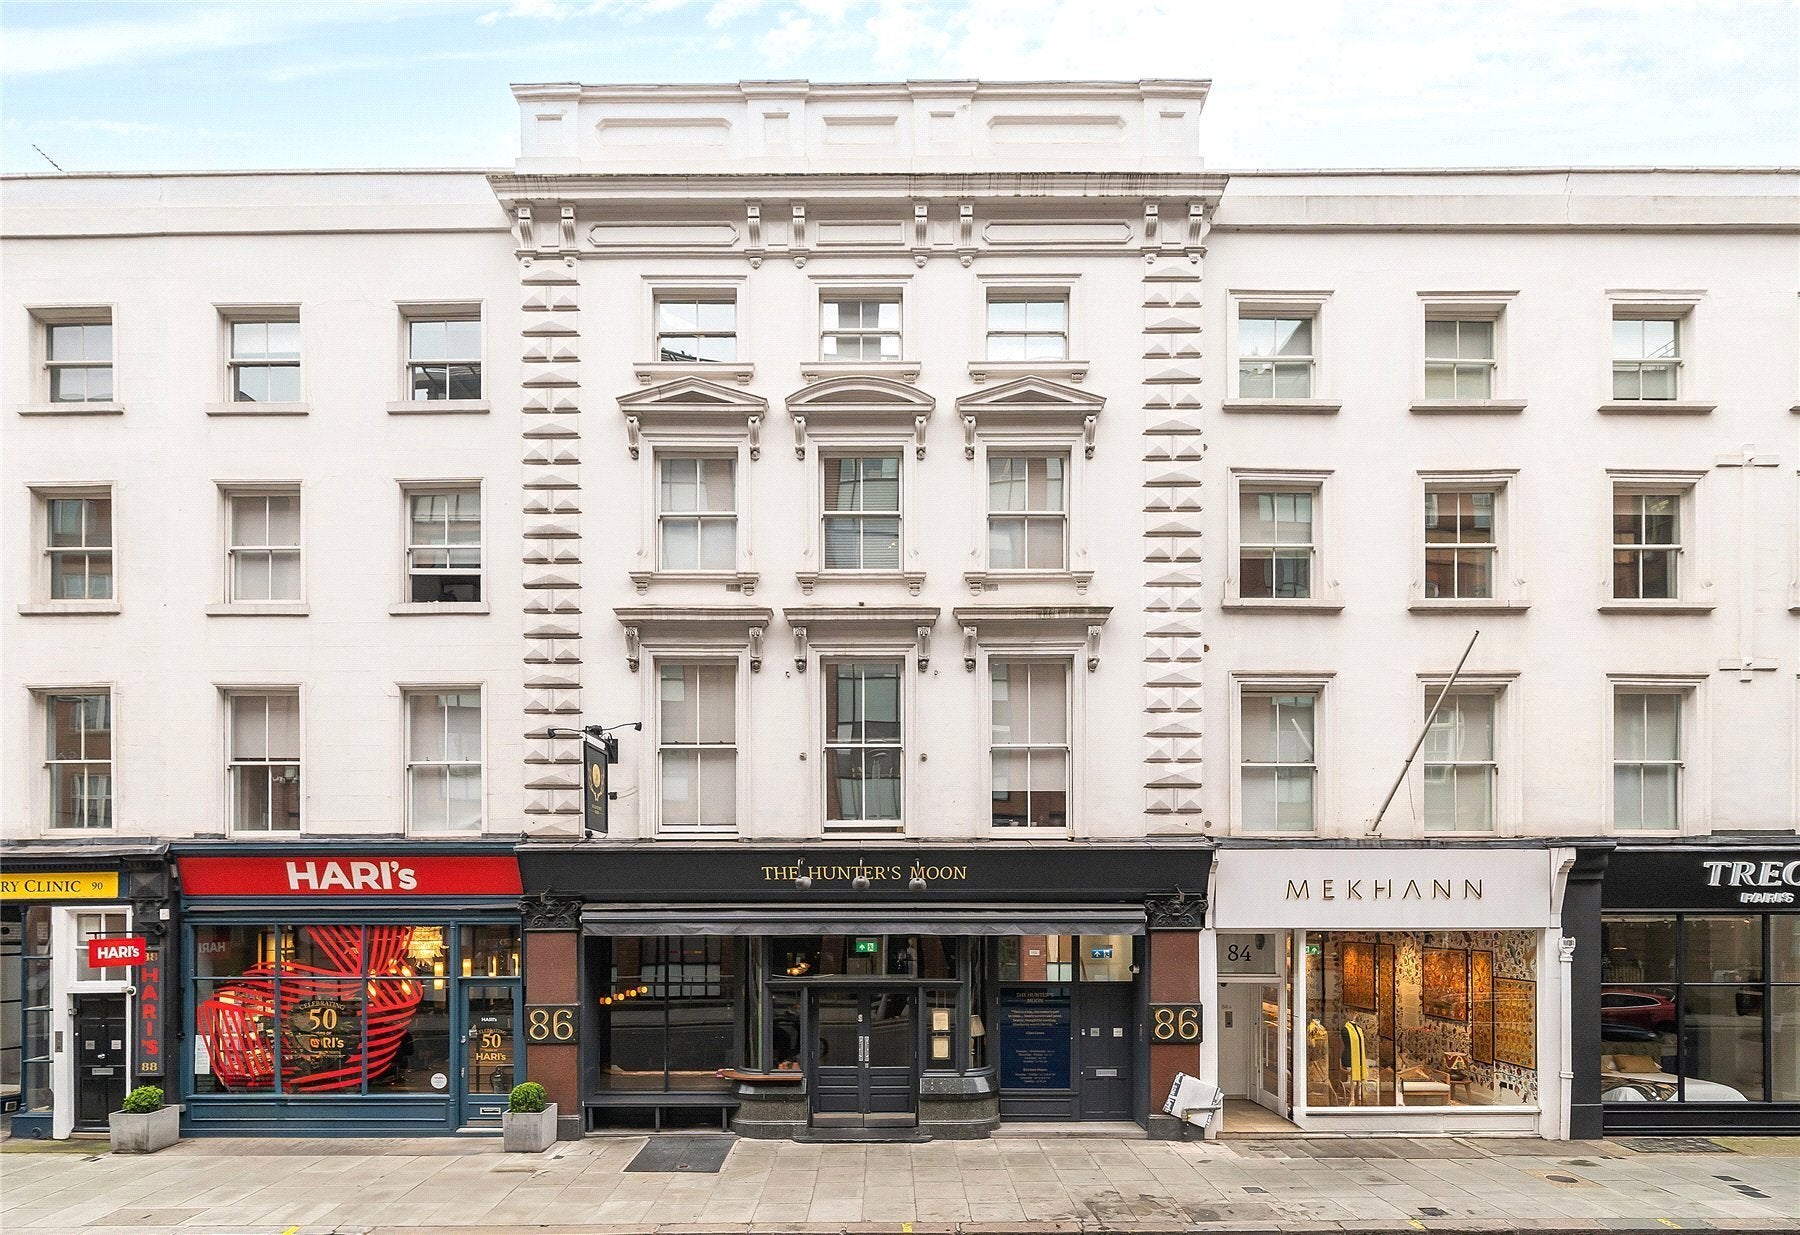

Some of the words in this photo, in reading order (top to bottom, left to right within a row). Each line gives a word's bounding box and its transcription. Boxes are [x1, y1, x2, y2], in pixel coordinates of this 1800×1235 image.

[761, 866, 798, 880] THE
[809, 866, 901, 880] HUNTER'S
[909, 866, 967, 880] MOON
[24, 880, 81, 893] CLINIC
[91, 882, 103, 890] 90
[1286, 879, 1482, 900] MEKHANN
[1740, 892, 1795, 903] PARIS
[1228, 944, 1251, 961] 84
[309, 1008, 337, 1030] 50
[530, 1009, 573, 1040] 86
[1155, 1007, 1198, 1040] 86
[481, 1033, 501, 1048] 50
[141, 1062, 158, 1071] 88
